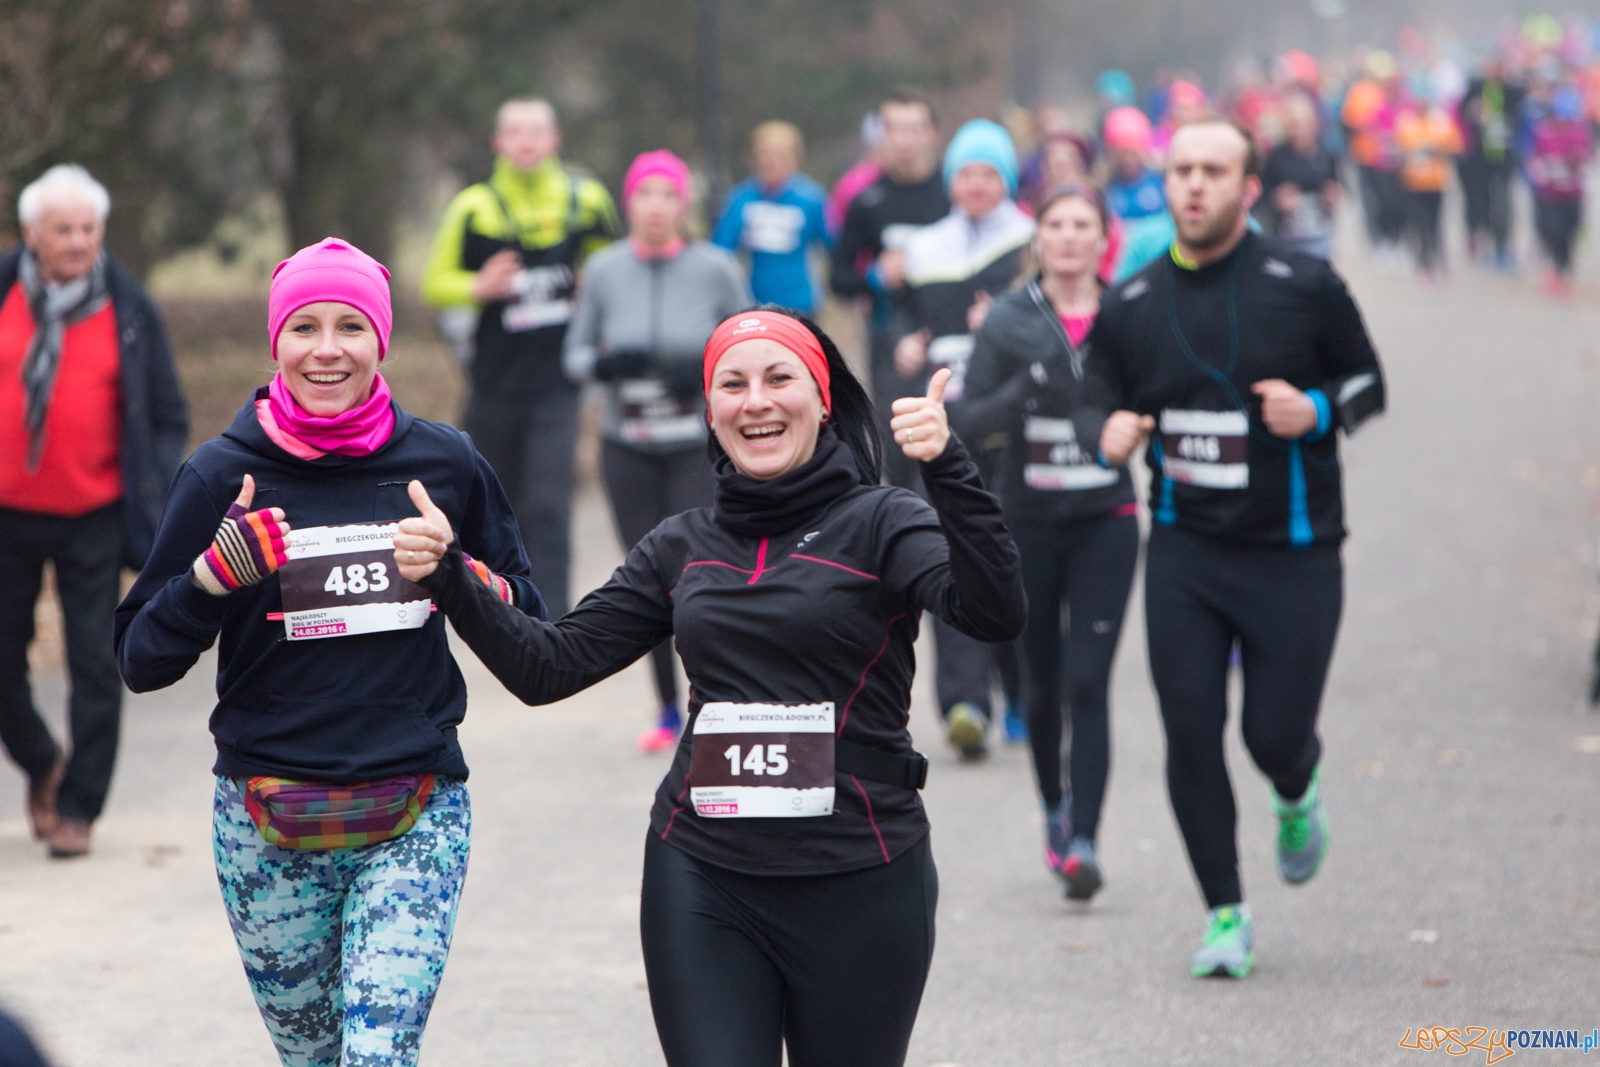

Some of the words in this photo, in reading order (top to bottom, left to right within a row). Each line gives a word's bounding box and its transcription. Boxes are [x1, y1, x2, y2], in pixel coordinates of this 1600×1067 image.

[324, 562, 390, 596] 483
[294, 625, 338, 636] 14.02.2016
[724, 744, 789, 776] 145
